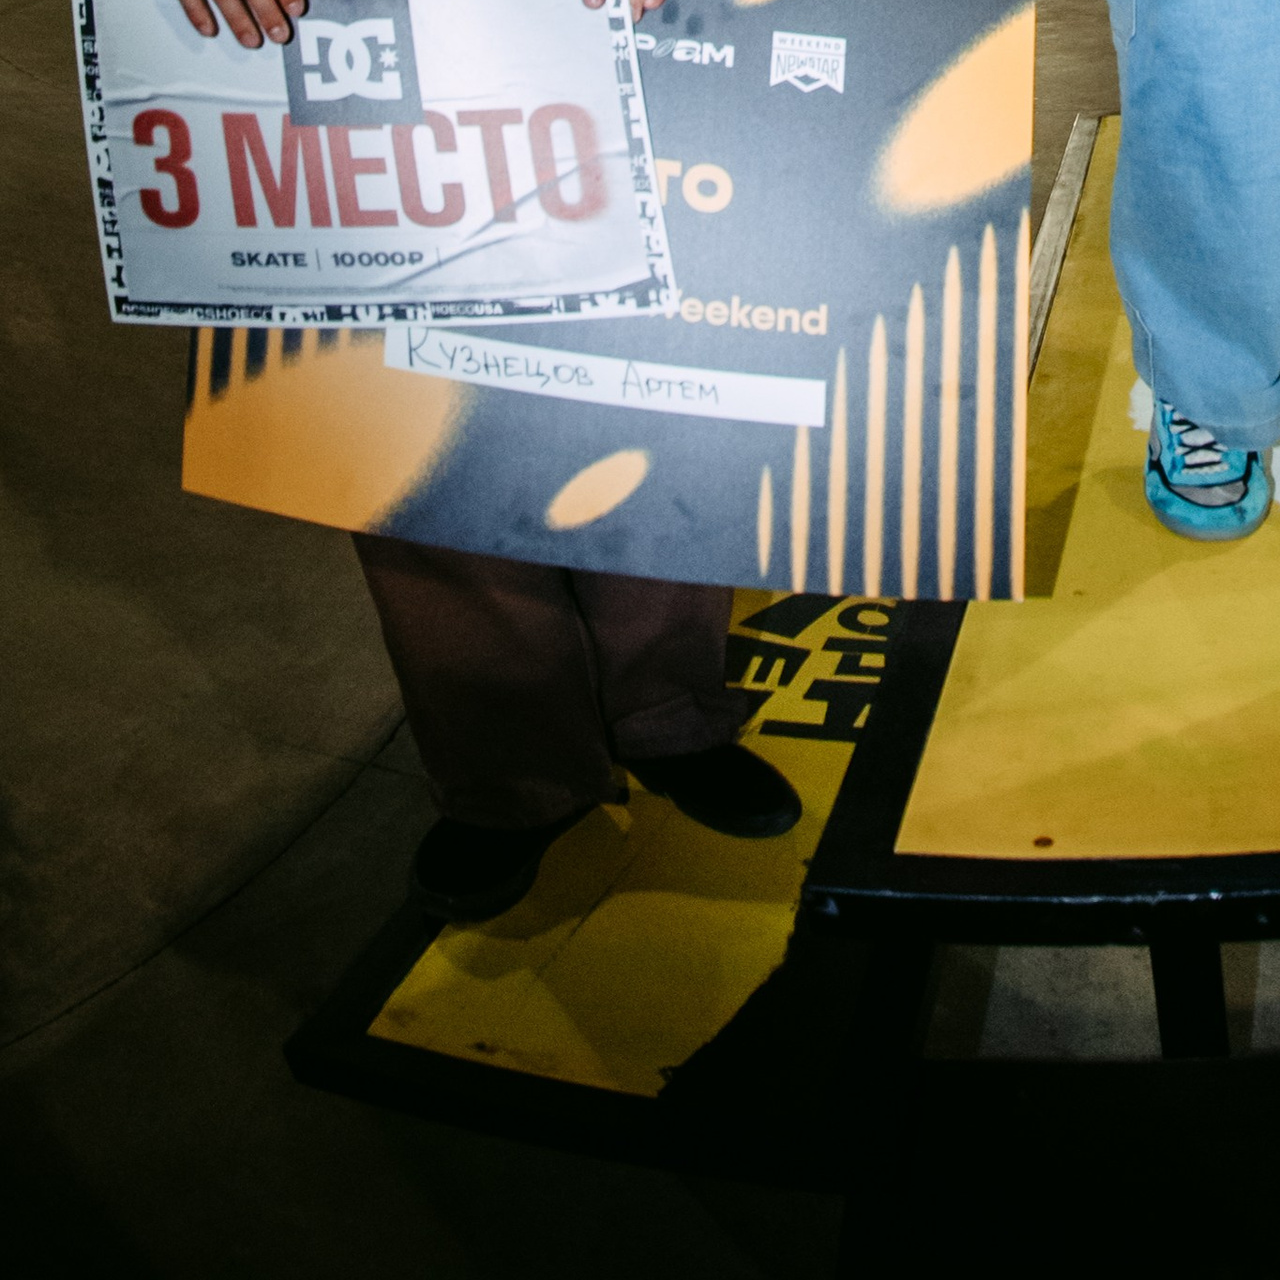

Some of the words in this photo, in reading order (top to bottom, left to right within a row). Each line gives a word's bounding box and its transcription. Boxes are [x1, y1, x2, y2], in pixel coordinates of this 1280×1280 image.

[132, 109, 200, 229] 3
[222, 105, 607, 229] МЕСТО
[231, 251, 308, 268] SKATE
